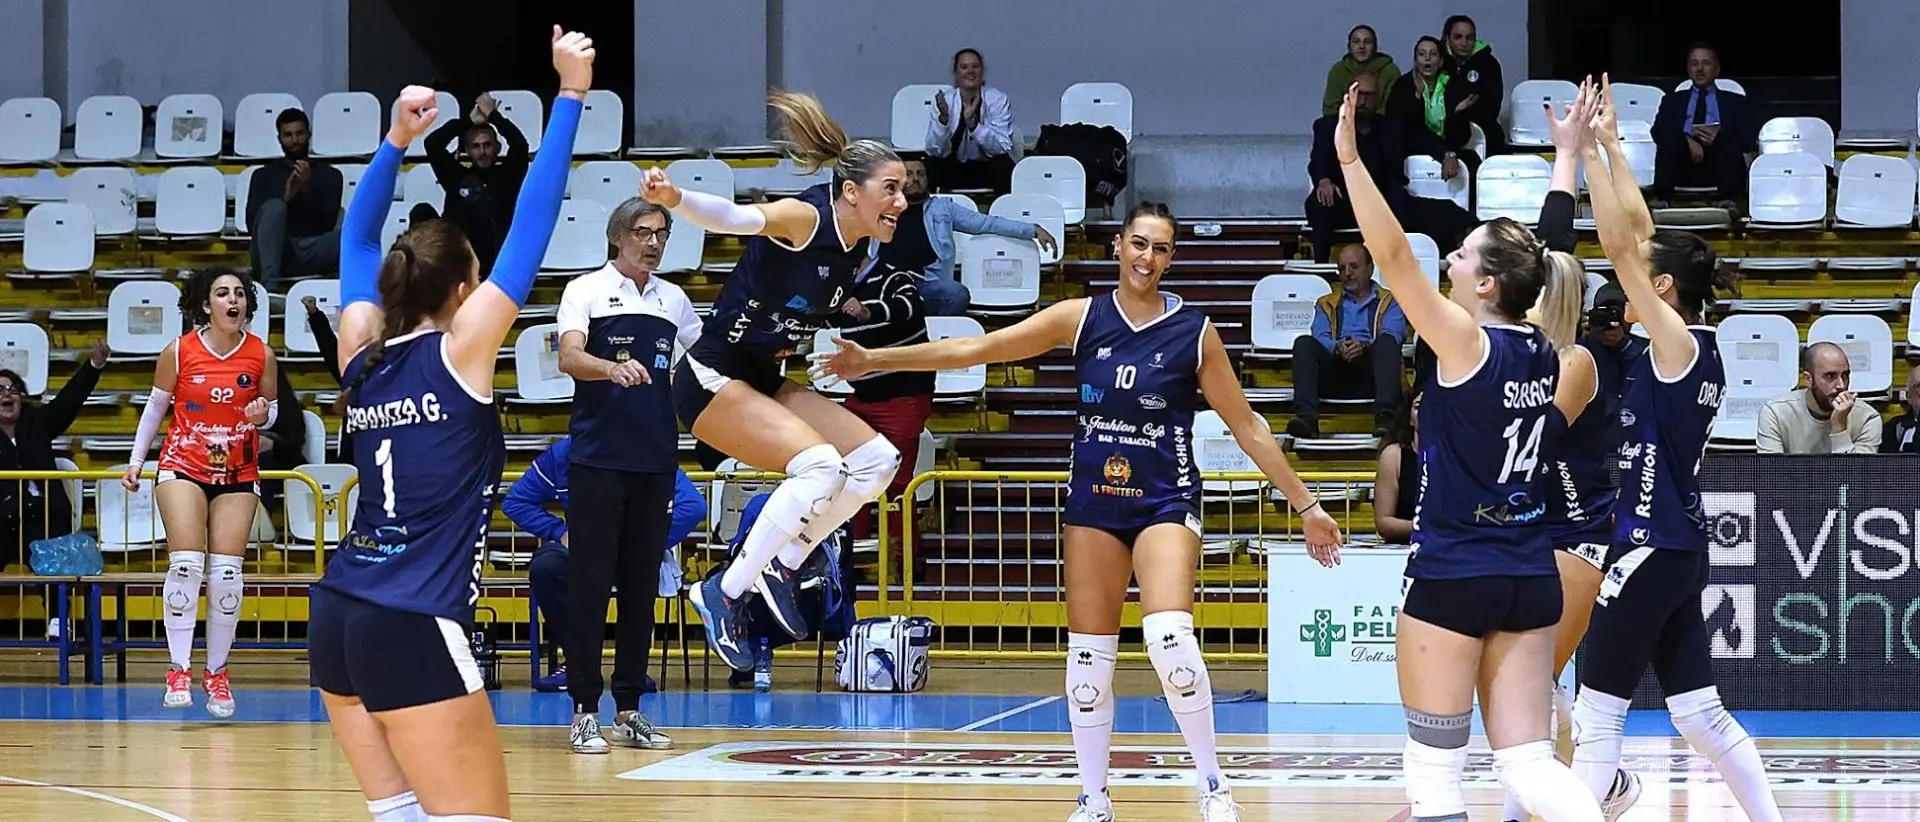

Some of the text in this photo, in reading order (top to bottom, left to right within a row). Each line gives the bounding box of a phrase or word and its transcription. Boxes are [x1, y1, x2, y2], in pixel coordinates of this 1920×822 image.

[1114, 364, 1137, 389] 10
[421, 392, 448, 422] G.
[1089, 415, 1138, 434] Fashion
[1098, 434, 1114, 444] BAR
[1497, 414, 1547, 484] 14
[374, 438, 397, 519] 1
[1091, 484, 1144, 498] IL FRUTTETO
[1634, 442, 1658, 519] REGHION
